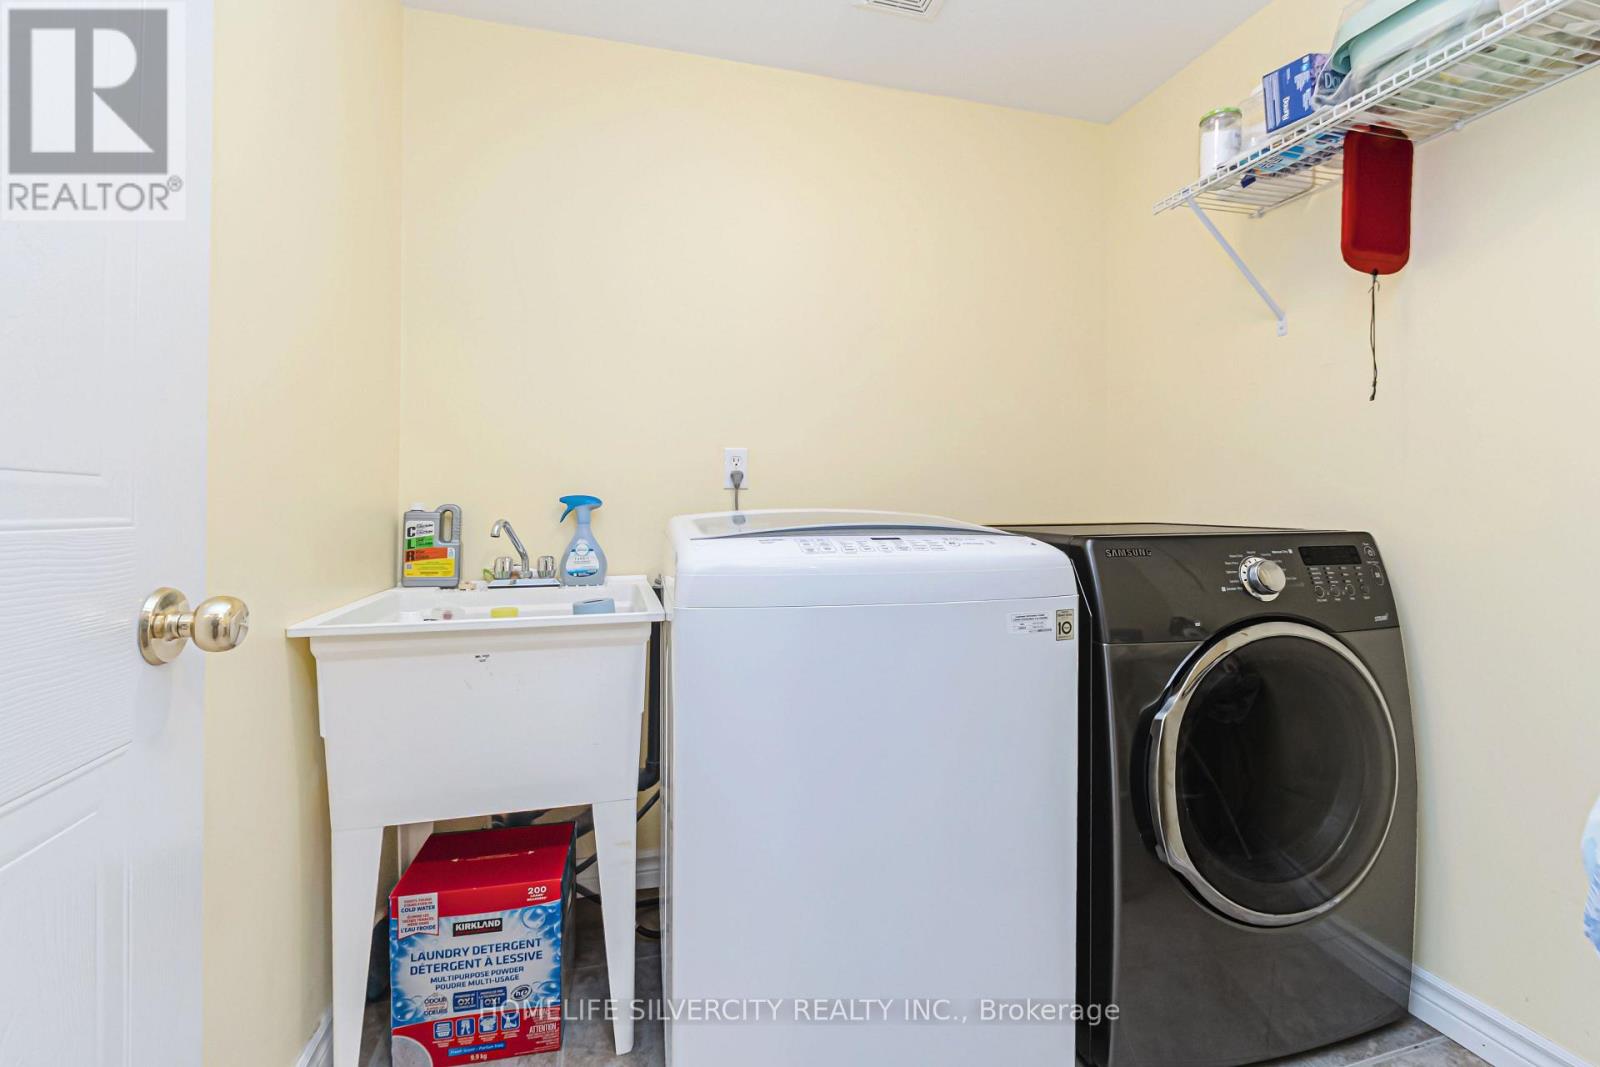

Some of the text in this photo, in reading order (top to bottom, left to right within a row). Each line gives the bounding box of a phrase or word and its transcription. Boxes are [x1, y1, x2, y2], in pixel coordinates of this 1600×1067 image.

[407, 526, 416, 537] C
[407, 538, 416, 549] L
[405, 550, 416, 562] R
[1105, 549, 1152, 557] SAMSUNG
[1058, 621, 1072, 635] 10
[527, 885, 547, 895] 200
[455, 919, 501, 932] KIRKLAND
[410, 938, 542, 962] LAUNDRY DETERGENT
[410, 950, 543, 976] DÉTERGENT À LESSIVE
[430, 966, 525, 984] MULTIPURPOSE POWDER
[435, 974, 520, 991] POUDRE MULTI-USAGE
